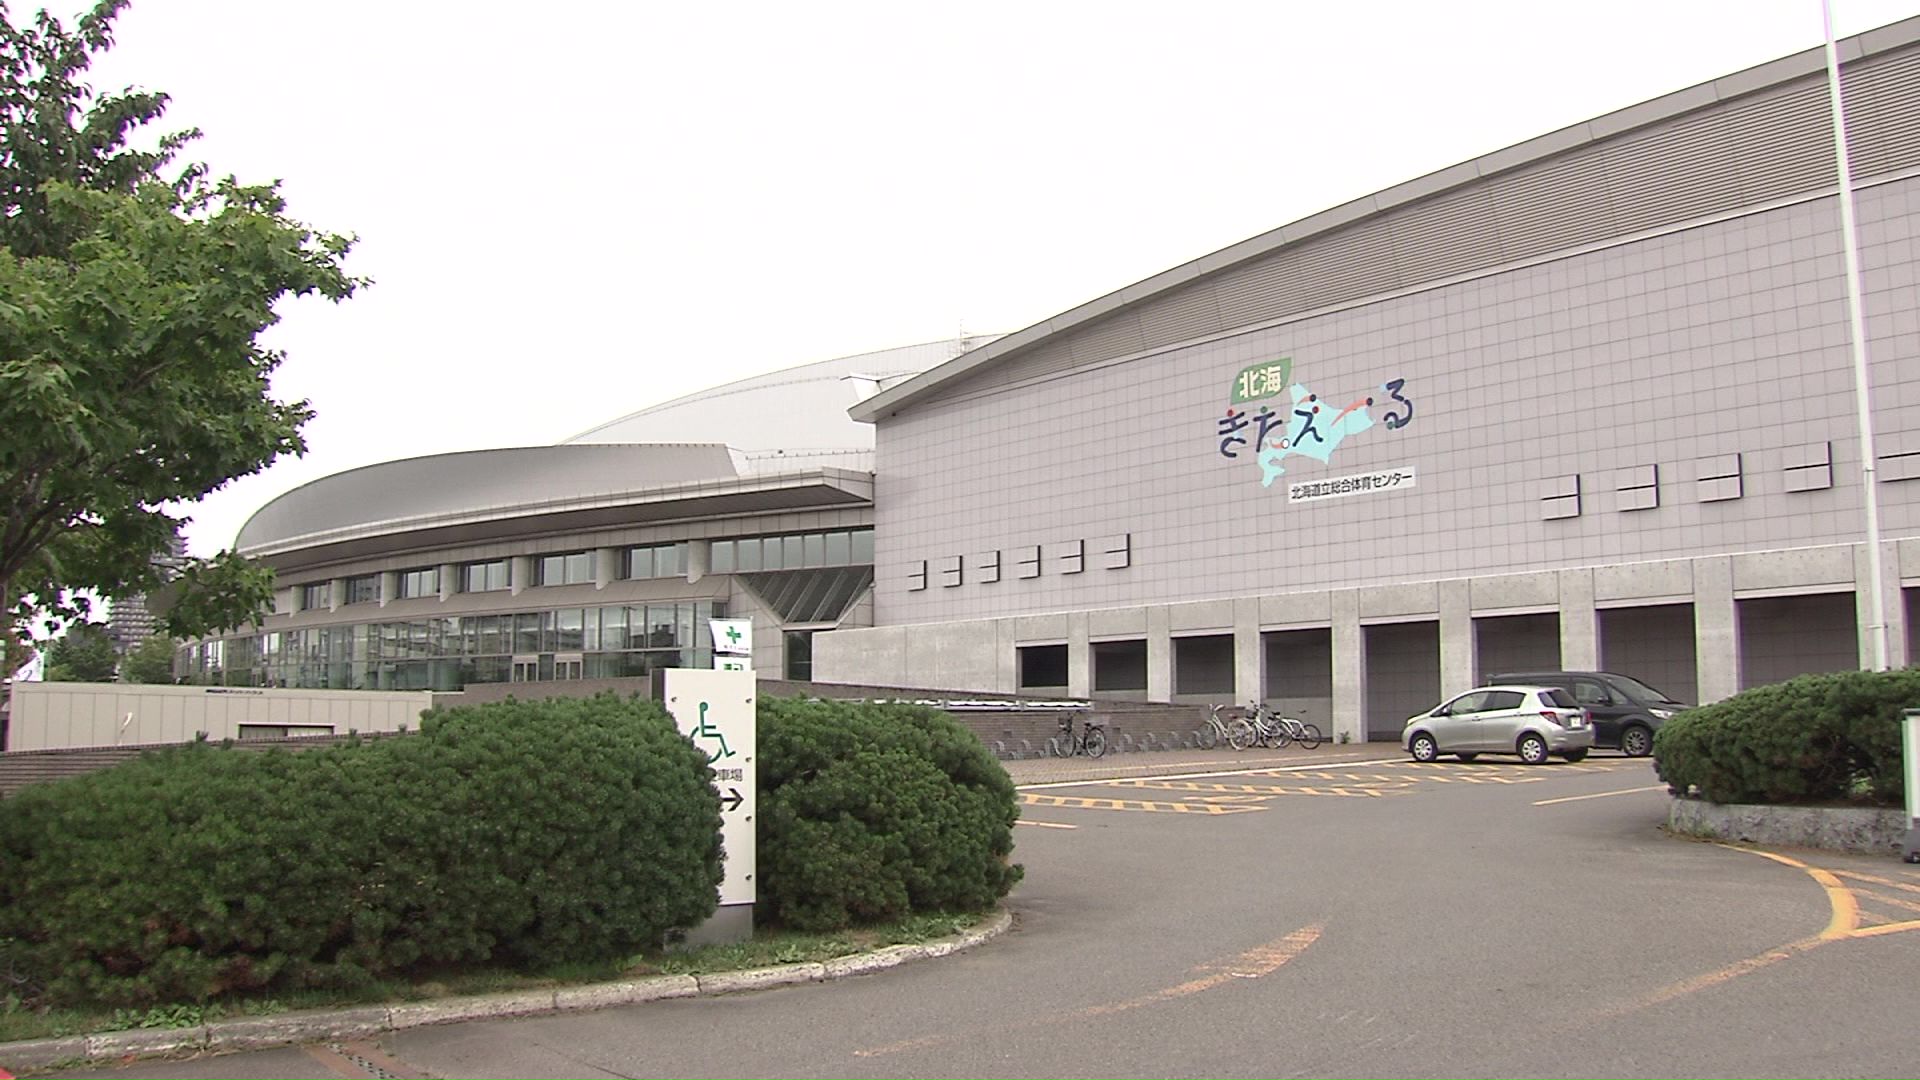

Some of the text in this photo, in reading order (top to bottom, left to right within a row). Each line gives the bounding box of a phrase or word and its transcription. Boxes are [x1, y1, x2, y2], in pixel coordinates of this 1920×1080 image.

[1239, 366, 1282, 399] 北海
[1291, 472, 1412, 500] 北海道立総合体育センター
[712, 768, 743, 782] 車場
